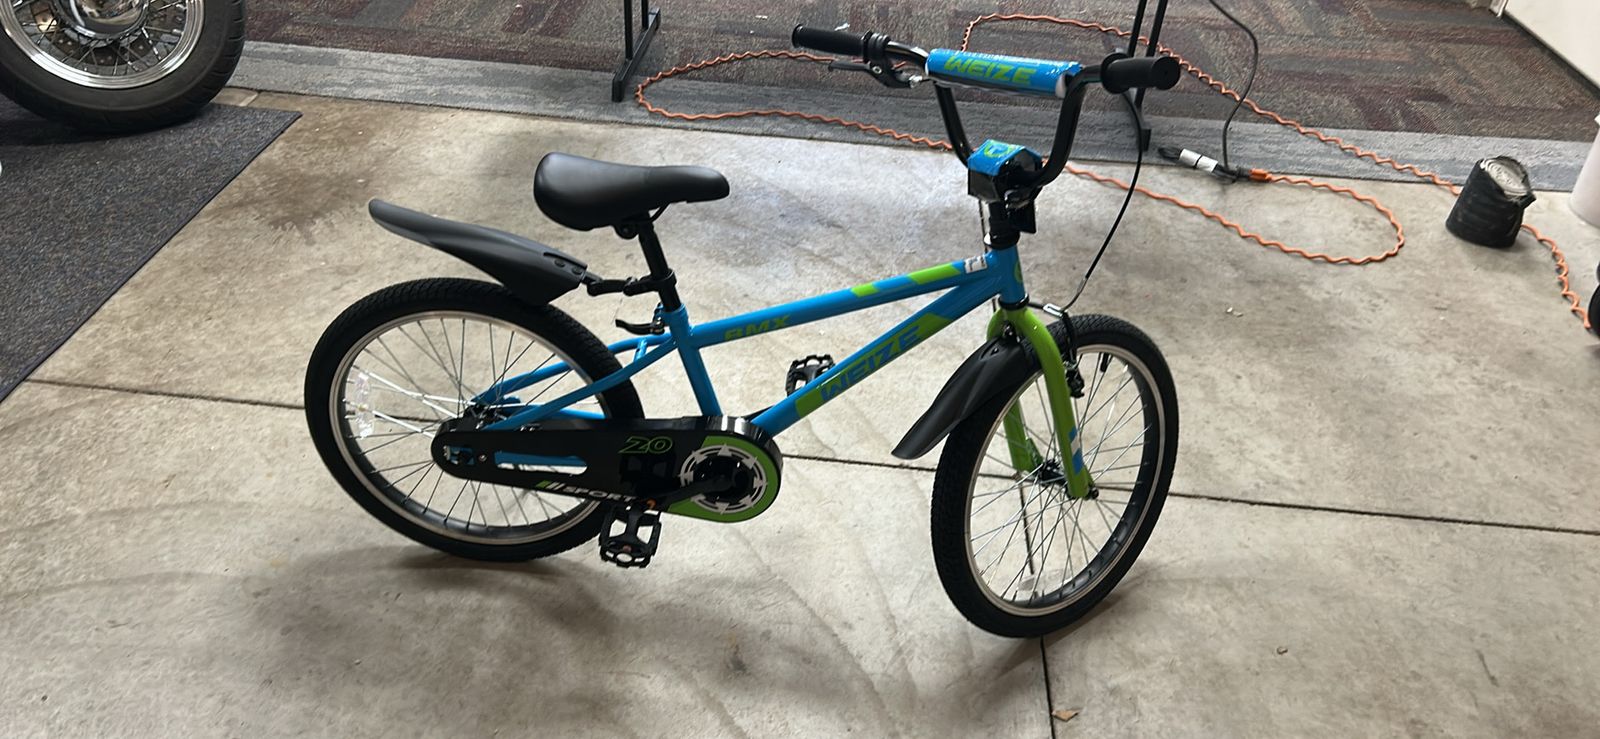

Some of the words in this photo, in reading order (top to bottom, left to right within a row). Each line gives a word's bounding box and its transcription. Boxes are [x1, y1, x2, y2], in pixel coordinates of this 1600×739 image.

[943, 56, 1037, 86] WEIZE
[820, 325, 921, 401] WEIZE
[617, 435, 673, 454] 20
[562, 485, 637, 502] SPORT
